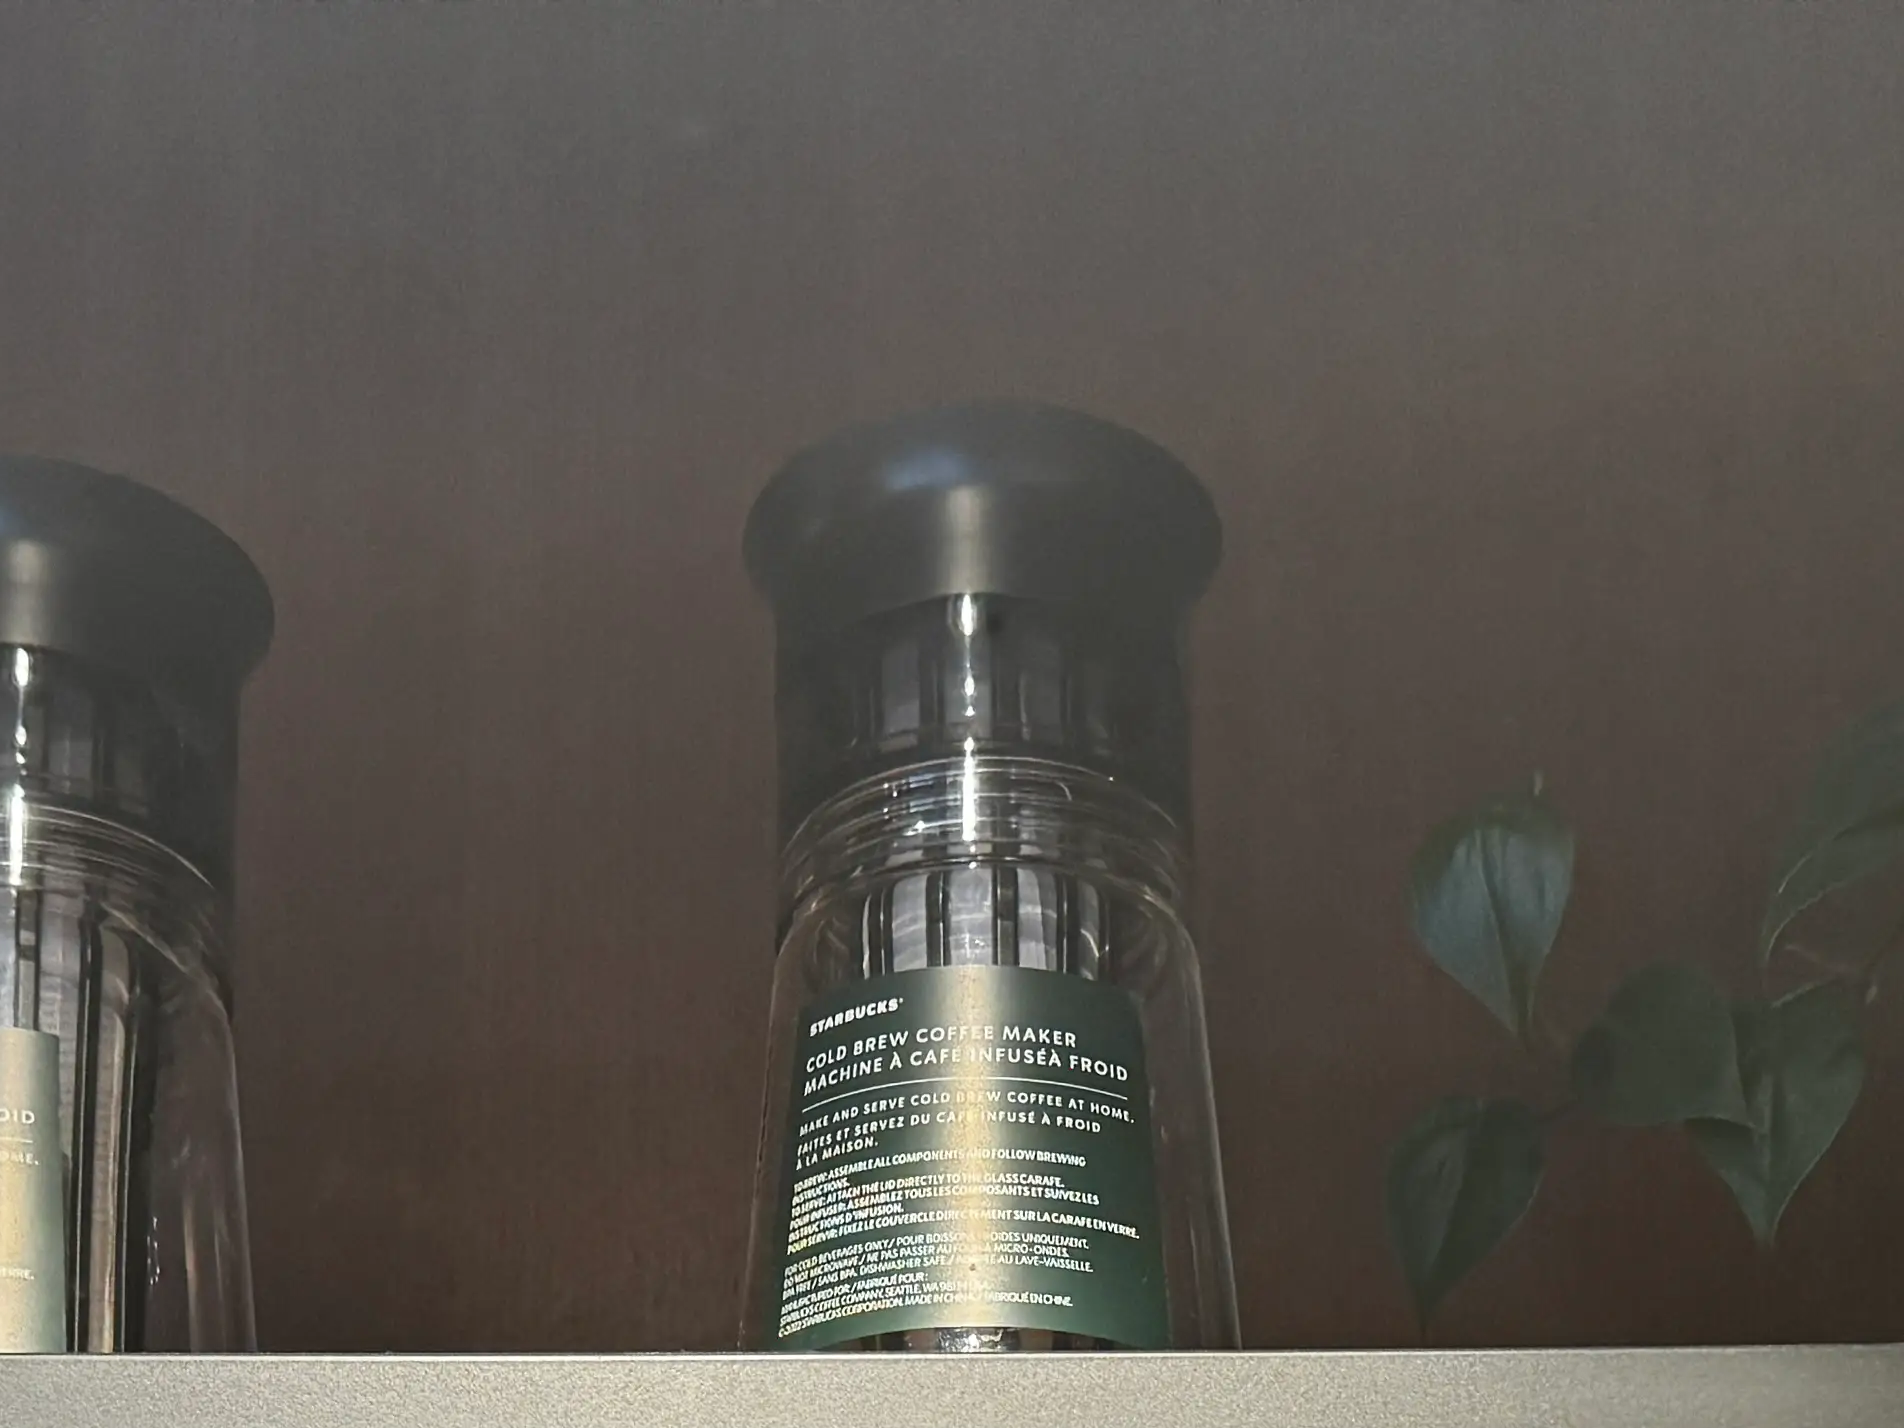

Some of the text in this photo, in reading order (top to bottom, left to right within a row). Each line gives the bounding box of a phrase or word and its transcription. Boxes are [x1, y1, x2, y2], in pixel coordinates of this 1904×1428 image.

[806, 1025, 1077, 1073] COLD BREW COFFEE MAKER
[804, 1057, 883, 1096] MACHINE
[1069, 1055, 1128, 1081] FROID
[797, 1132, 832, 1157] FAITES
[836, 1127, 850, 1141] ET
[854, 1115, 905, 1137] SERVEZ
[910, 1113, 931, 1126] DU
[1056, 1115, 1101, 1133] FROID
[799, 1115, 829, 1136] MAKE
[832, 1106, 859, 1123] AND
[863, 1096, 905, 1115] SERVE
[911, 1092, 950, 1107] COLD
[1007, 1091, 1063, 1107] COFFEE
[1068, 1098, 1085, 1111] AT
[1090, 1102, 1135, 1124] HOME.
[806, 1153, 818, 1167] LA
[822, 1135, 879, 1161] MAISON.
